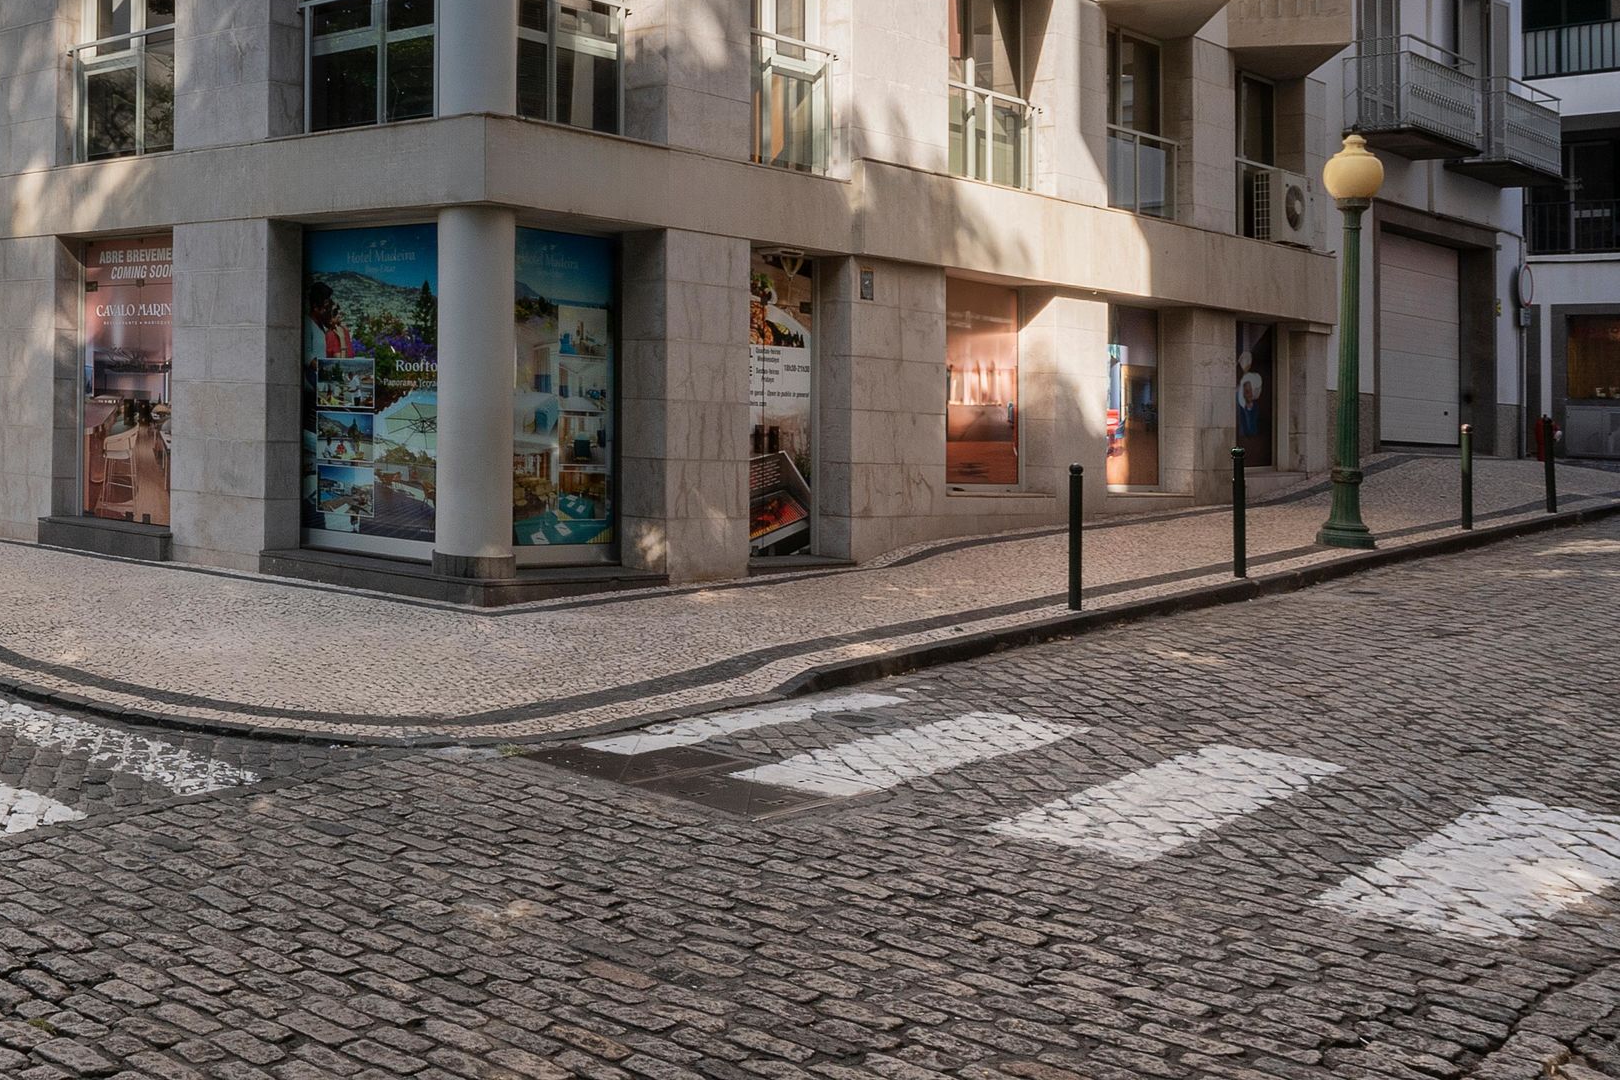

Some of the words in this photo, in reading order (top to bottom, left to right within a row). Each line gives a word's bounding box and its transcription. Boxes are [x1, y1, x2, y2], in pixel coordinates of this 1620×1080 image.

[99, 251, 124, 264] ABRE
[347, 248, 372, 264] Hotel
[375, 247, 417, 263] Madeira
[111, 265, 148, 280] COMING
[96, 304, 135, 317] CAVALO
